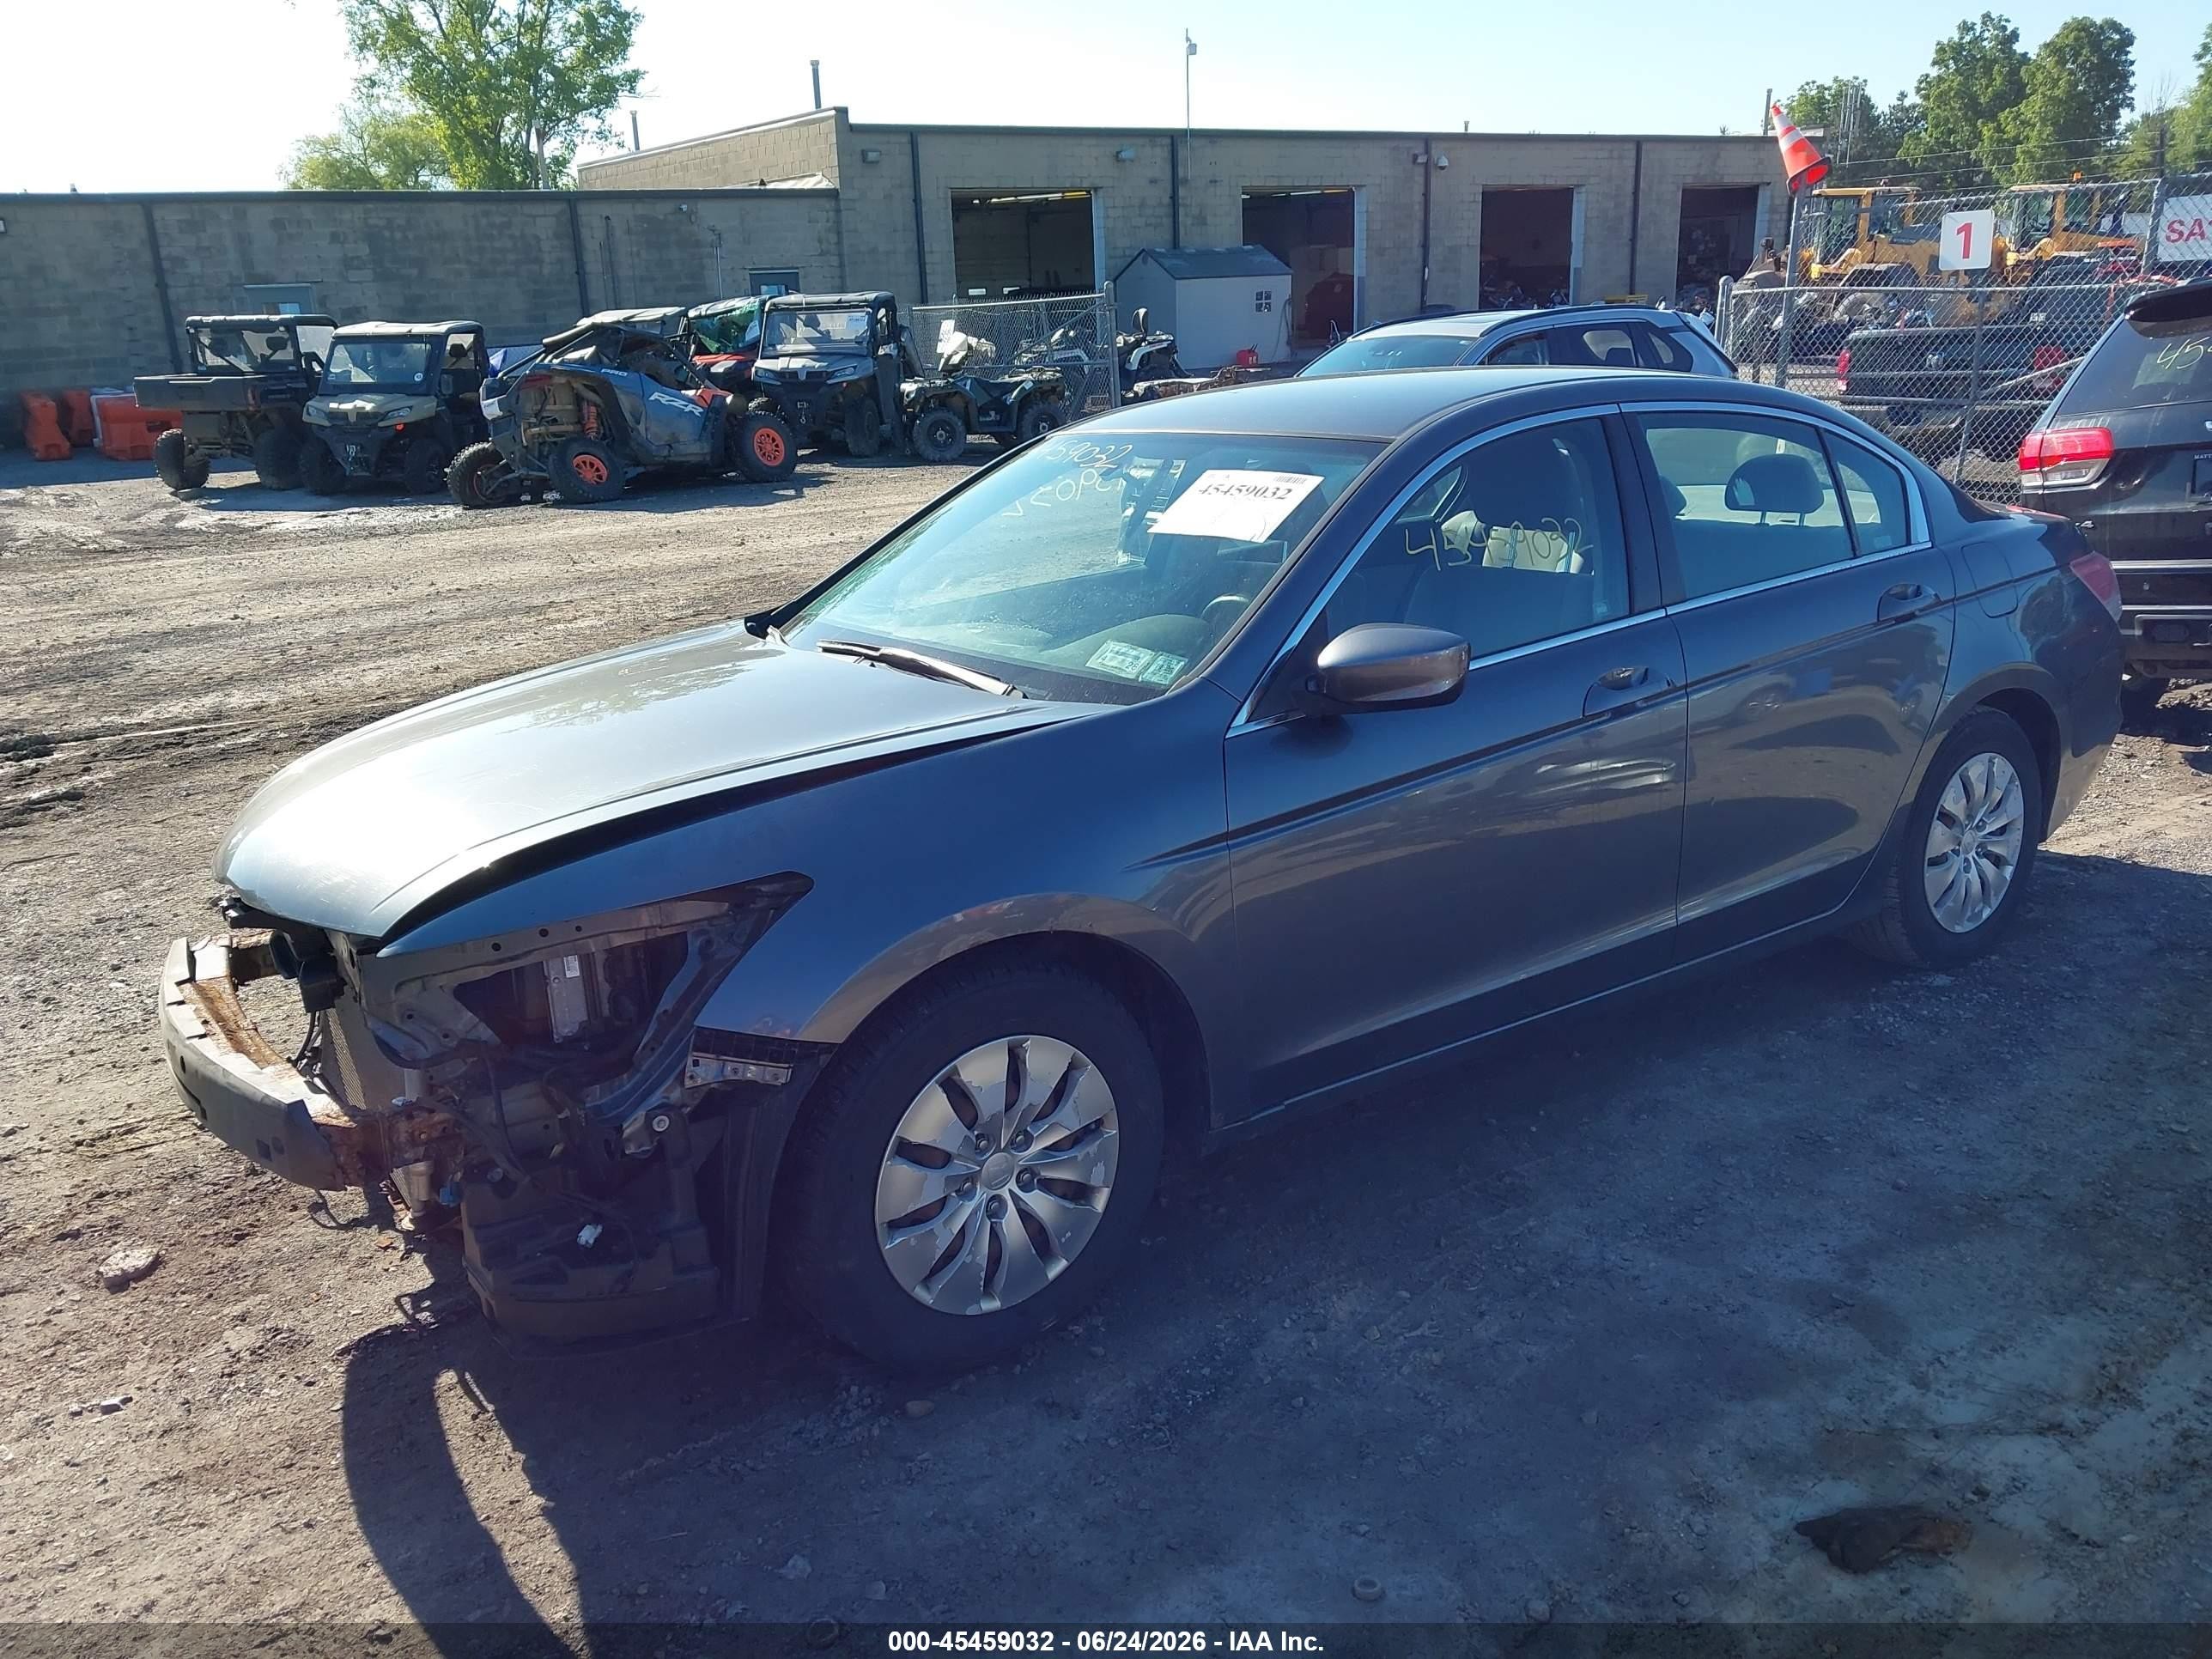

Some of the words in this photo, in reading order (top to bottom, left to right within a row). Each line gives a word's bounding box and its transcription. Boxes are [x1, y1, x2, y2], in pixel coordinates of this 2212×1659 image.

[1955, 222, 1973, 260] 1
[2165, 217, 2212, 244] SA
[2156, 336, 2212, 370] 45
[600, 368, 629, 377] PRO
[648, 391, 705, 418] RZR
[1198, 483, 1294, 501] 45459032
